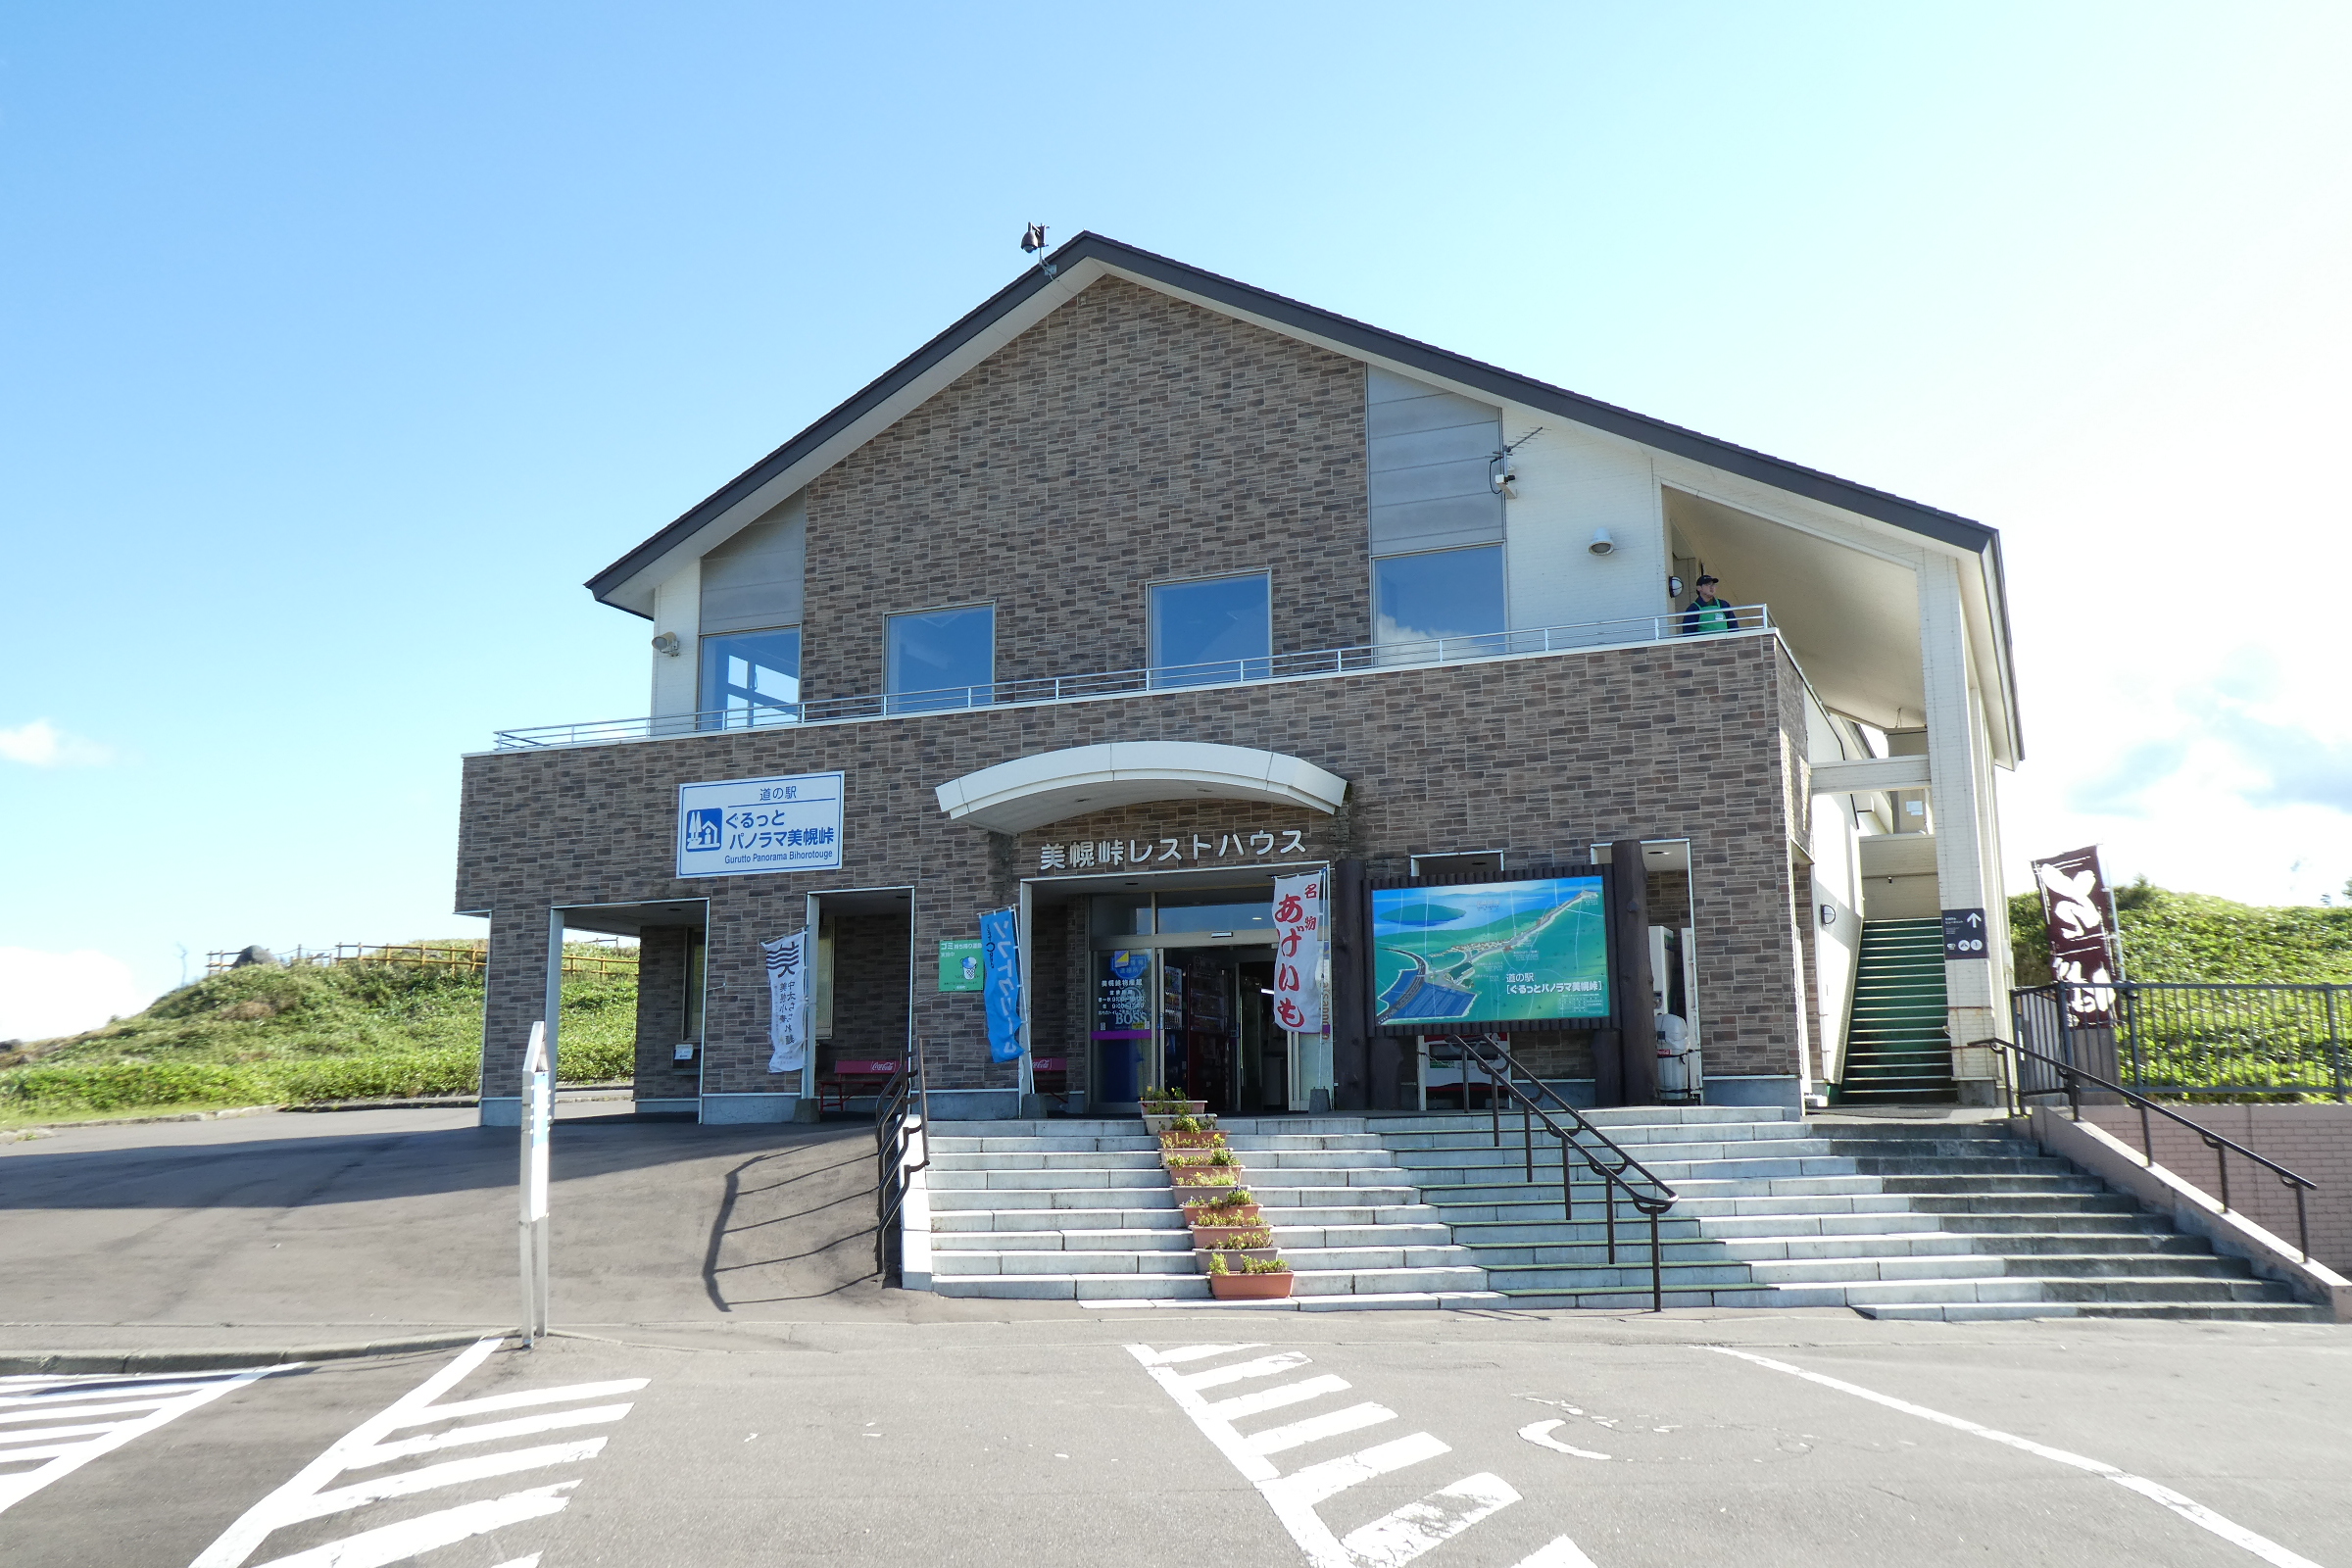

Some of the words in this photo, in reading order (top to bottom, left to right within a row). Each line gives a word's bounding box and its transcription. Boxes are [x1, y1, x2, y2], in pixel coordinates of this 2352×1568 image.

[760, 786, 797, 801] 道の駅
[725, 809, 785, 829] ぐるっと
[729, 826, 835, 850] パノラマ美幌峠
[724, 855, 752, 864] Gurutto
[753, 852, 788, 862] Panorama
[789, 850, 833, 860] Bihorotouge
[1040, 829, 1306, 870] 美幌峠レストハウス
[1303, 883, 1318, 931] 名物
[1275, 893, 1305, 1028] あげいも
[1506, 972, 1535, 983] 道の駅
